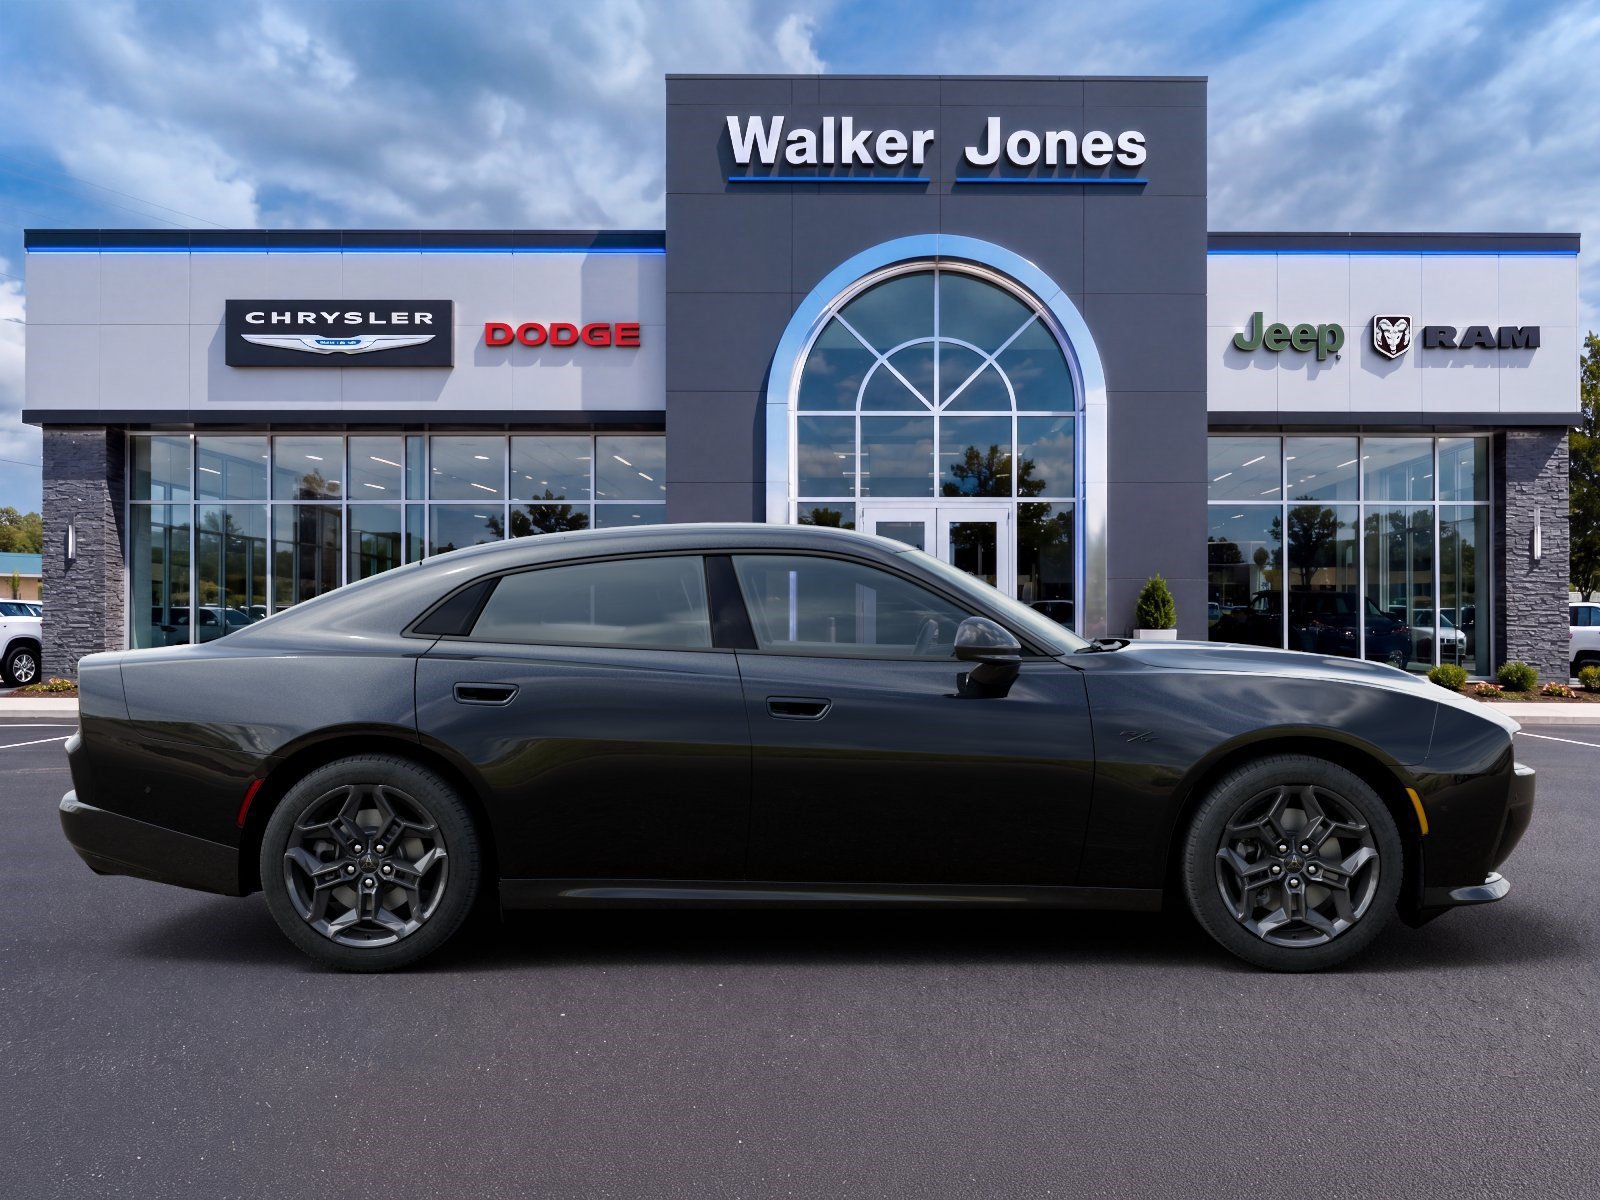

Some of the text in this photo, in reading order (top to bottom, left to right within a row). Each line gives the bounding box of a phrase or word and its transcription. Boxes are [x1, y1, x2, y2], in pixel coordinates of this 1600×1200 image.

[727, 115, 1148, 167] Walker Jones
[245, 311, 434, 325] CHRYSLER
[485, 322, 641, 347] DODGE
[1233, 311, 1345, 361] Jeep
[1424, 325, 1541, 348] RAM
